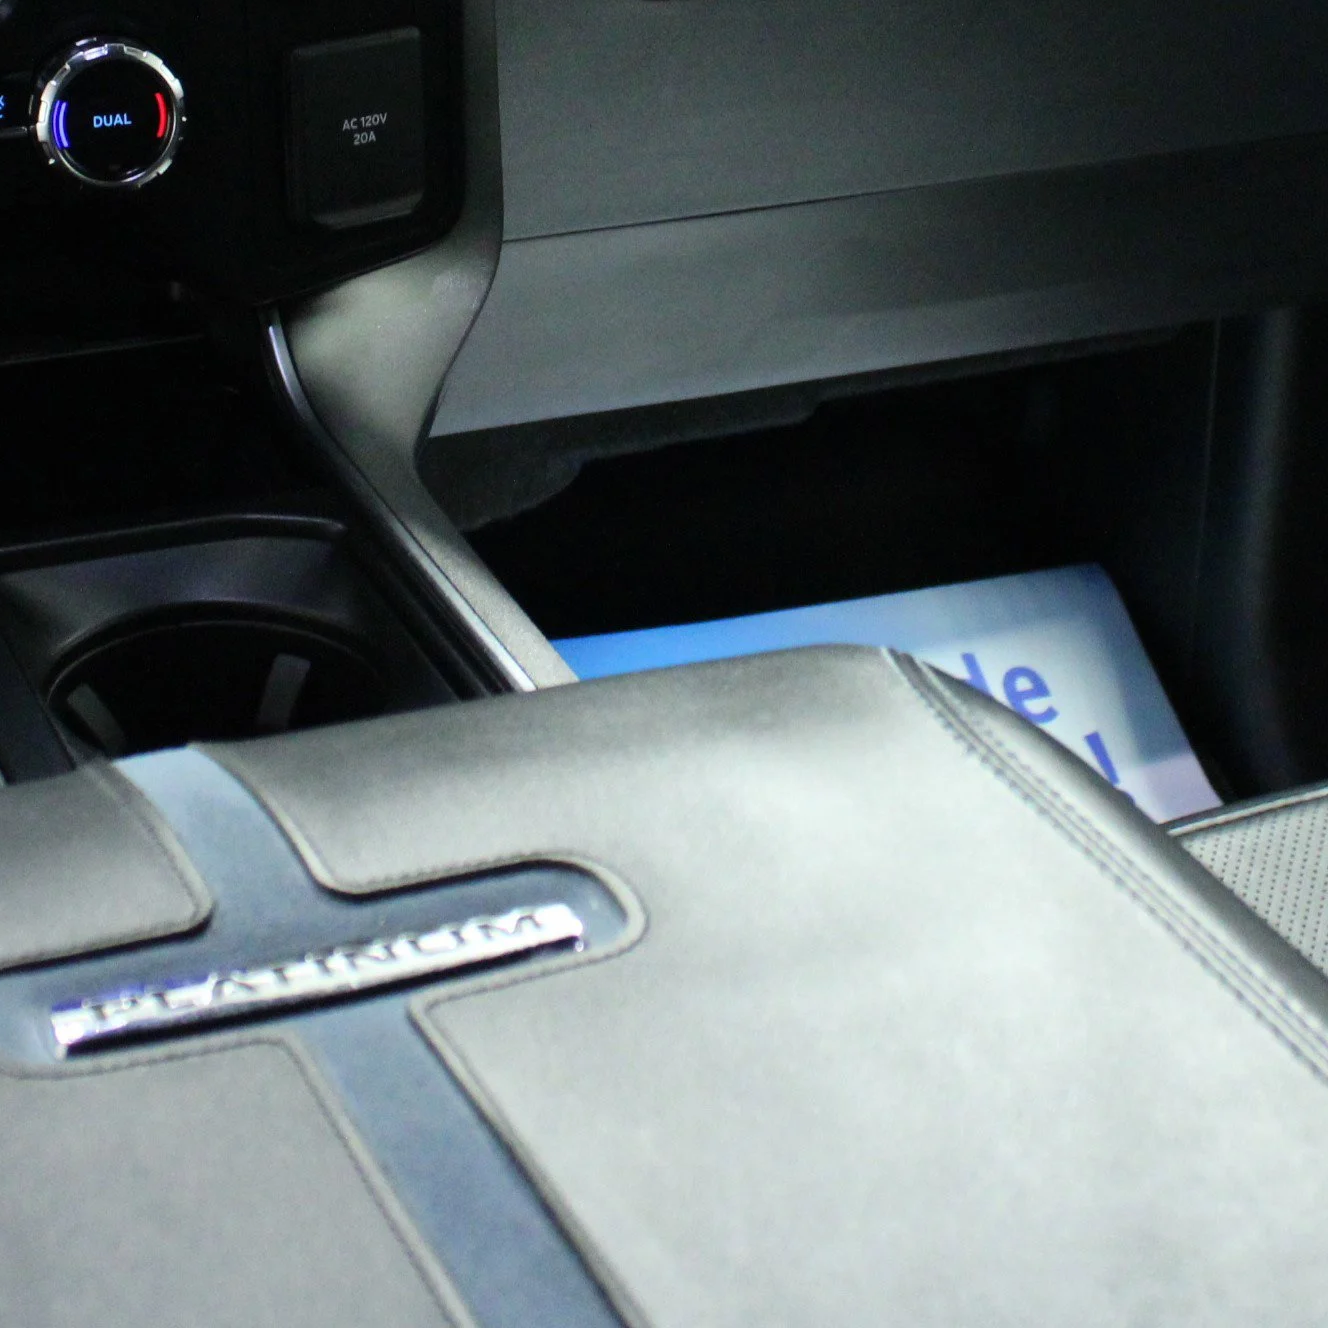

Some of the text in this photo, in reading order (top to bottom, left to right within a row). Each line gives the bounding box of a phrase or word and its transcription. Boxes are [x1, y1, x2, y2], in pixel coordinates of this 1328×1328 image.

[92, 111, 133, 129] DUAL
[341, 112, 389, 132] AC 120V
[352, 130, 377, 145] 20A
